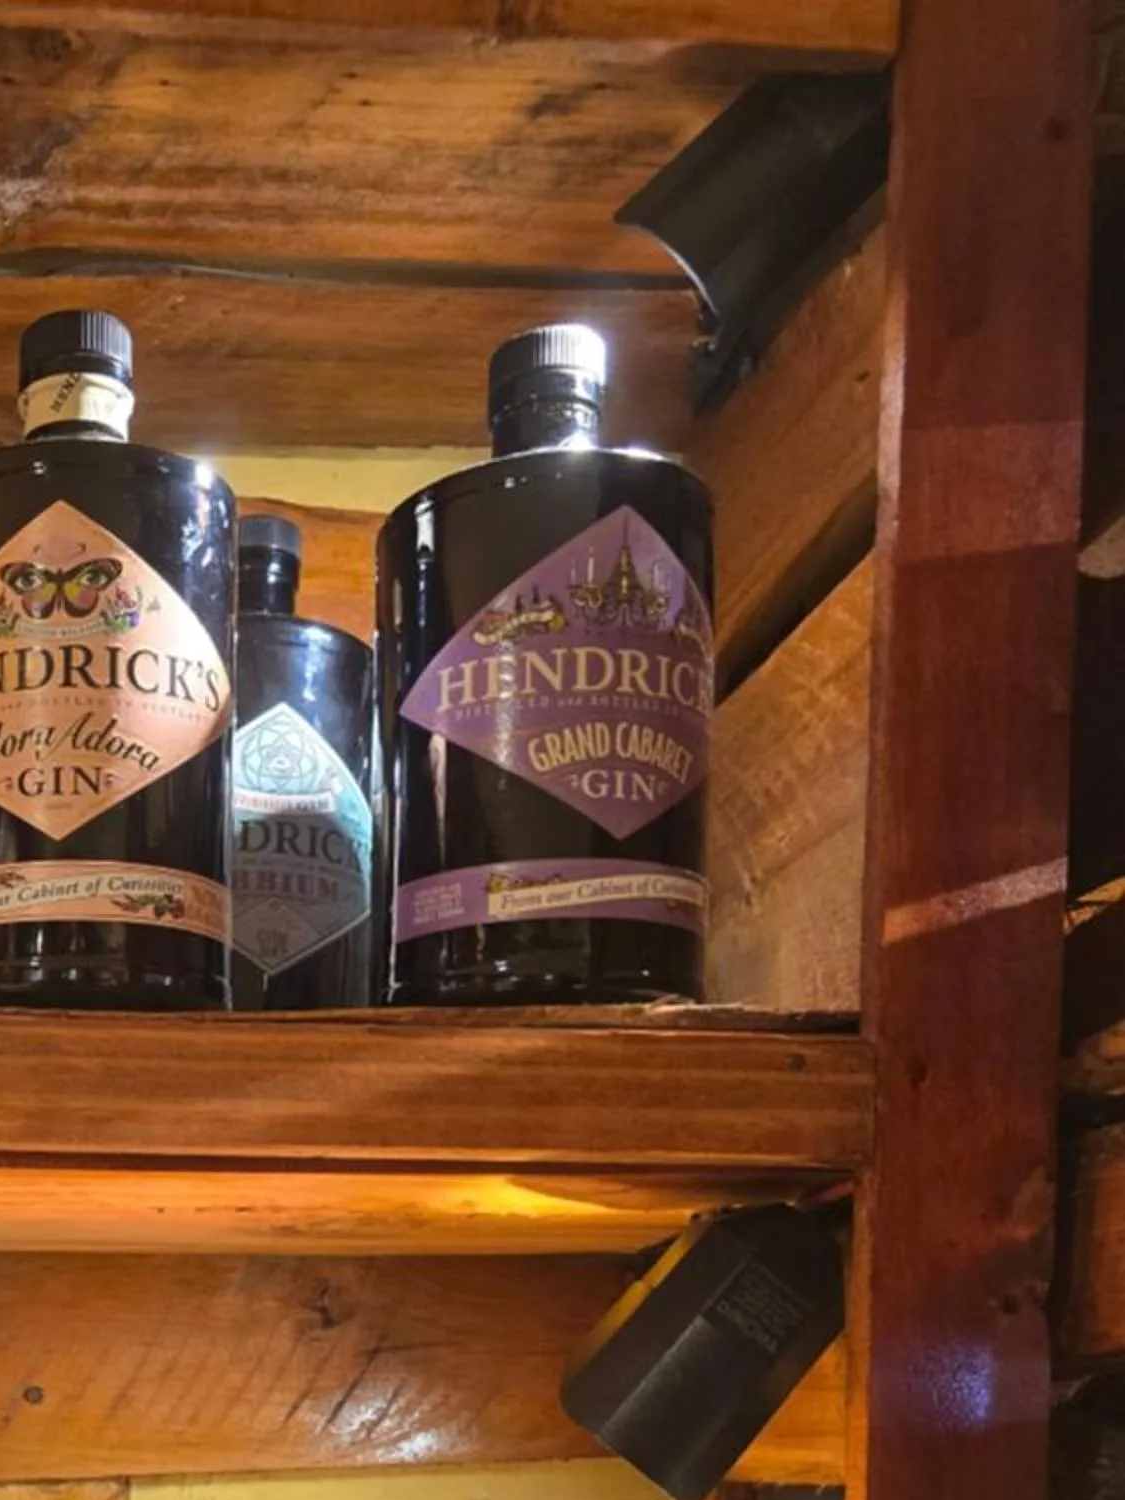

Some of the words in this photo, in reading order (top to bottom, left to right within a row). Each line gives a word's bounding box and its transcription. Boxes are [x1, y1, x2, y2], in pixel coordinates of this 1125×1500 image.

[526, 721, 612, 774] GRAND
[614, 722, 695, 785] CABARET
[17, 766, 103, 798] GIN
[580, 768, 658, 802] GIN
